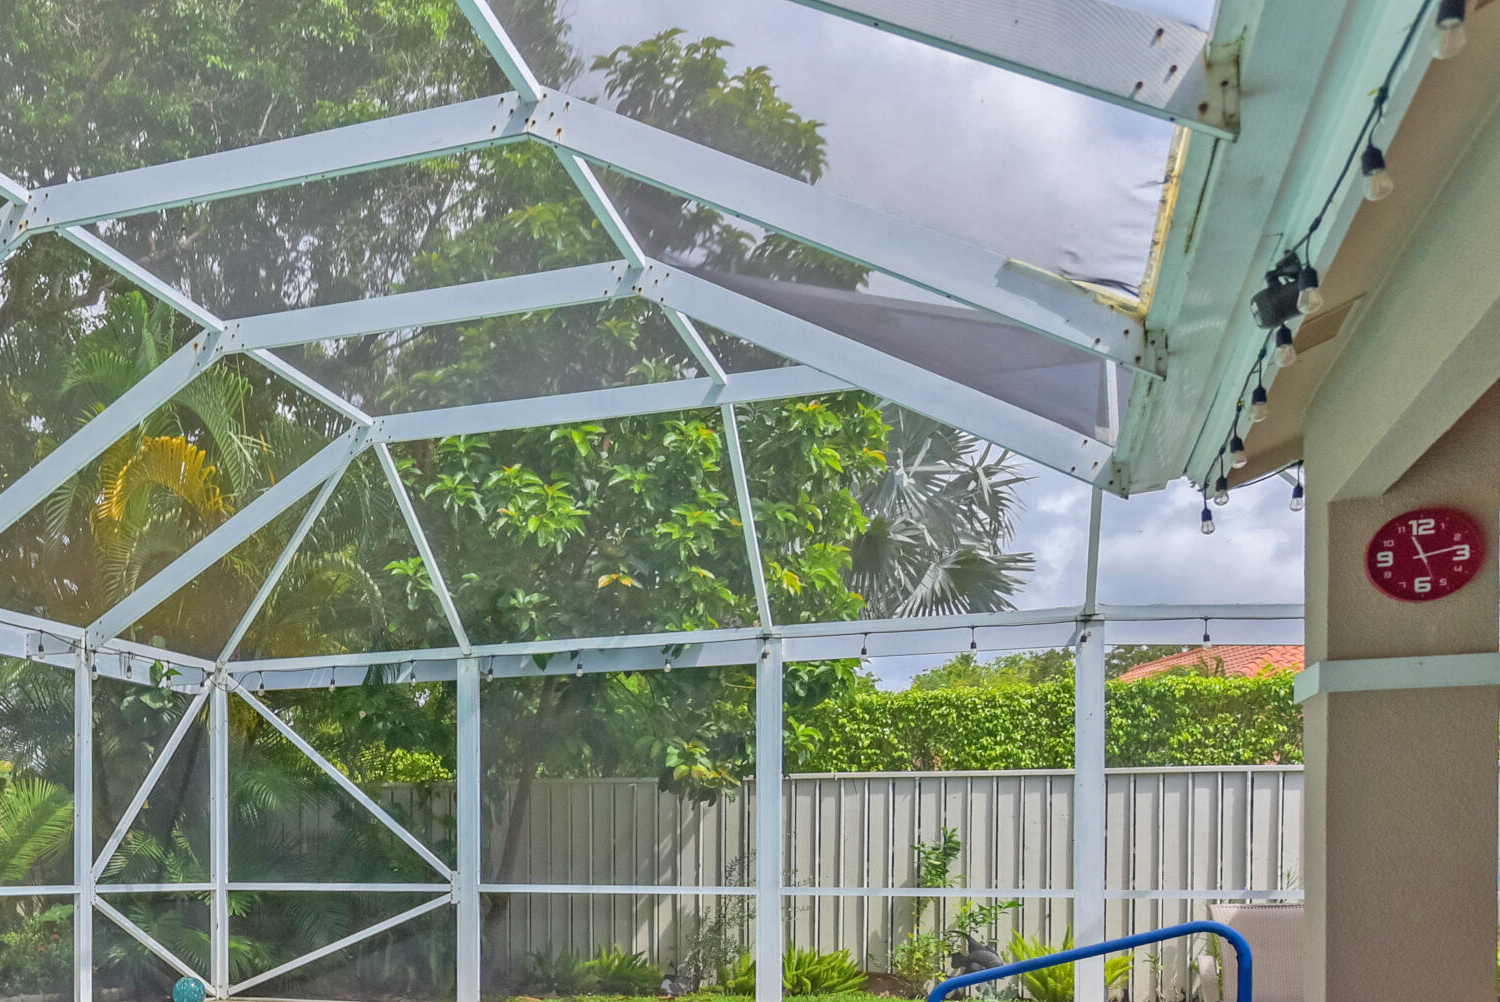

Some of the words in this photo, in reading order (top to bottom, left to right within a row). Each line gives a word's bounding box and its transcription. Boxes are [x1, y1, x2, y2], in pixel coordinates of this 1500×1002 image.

[1398, 526, 1406, 534] 11
[1408, 518, 1435, 535] 12
[1383, 539, 1394, 547] 10
[1453, 533, 1461, 541] 2
[1452, 544, 1470, 561] 3
[1376, 551, 1393, 567] 9
[1414, 577, 1431, 593] 6
[1440, 578, 1447, 586] 5
